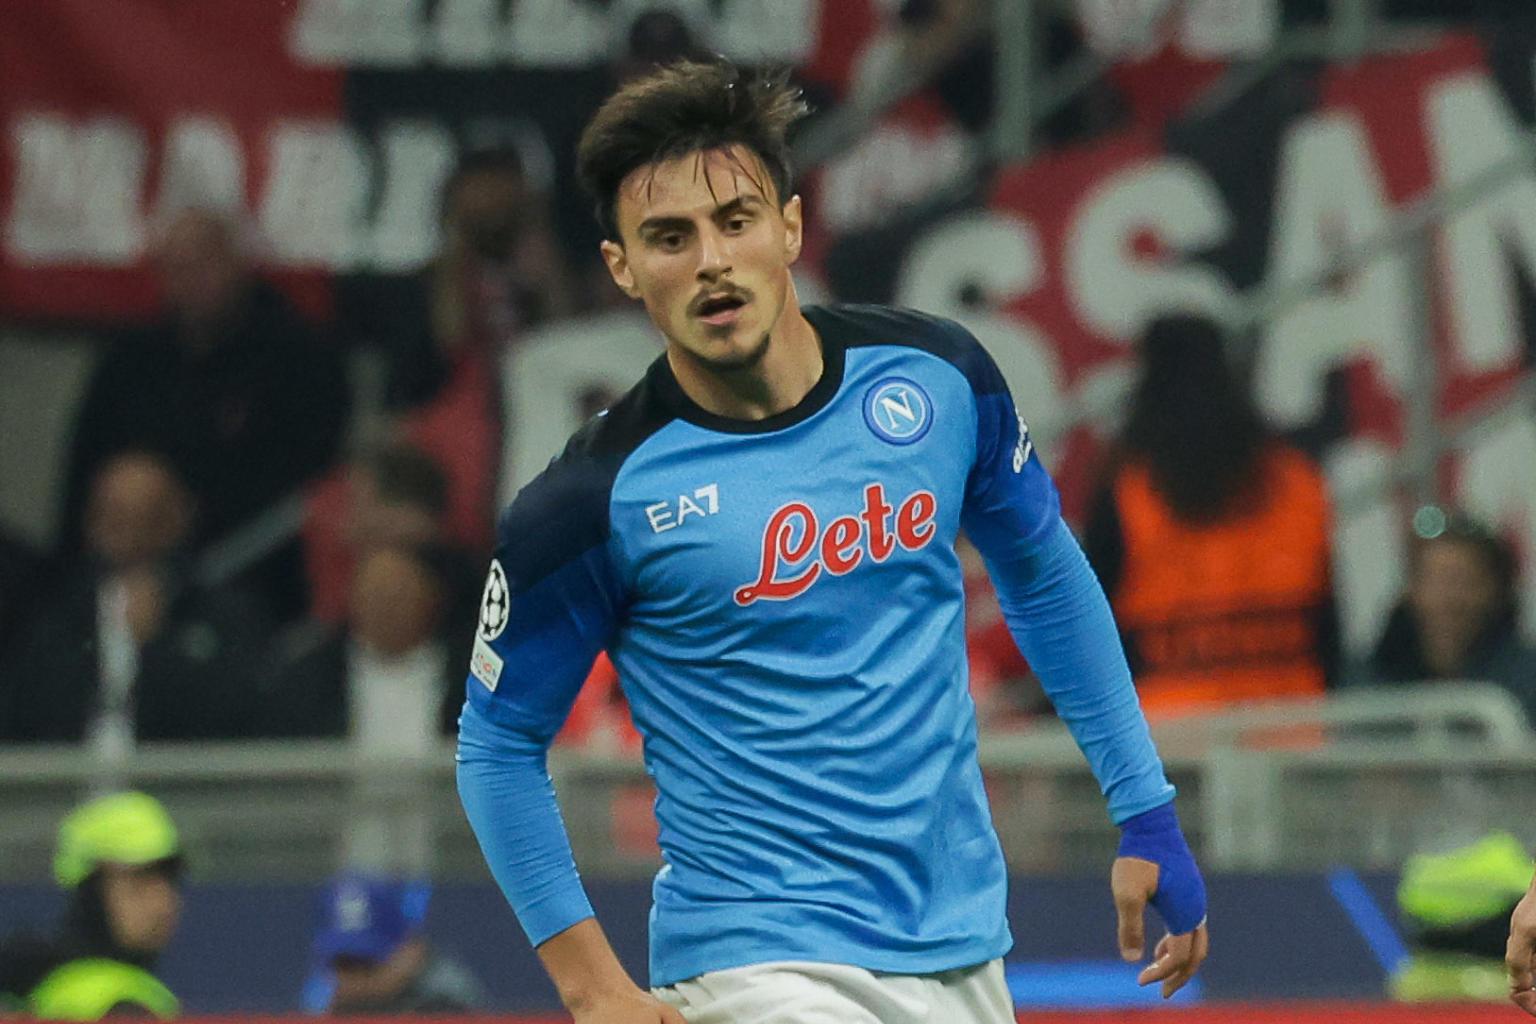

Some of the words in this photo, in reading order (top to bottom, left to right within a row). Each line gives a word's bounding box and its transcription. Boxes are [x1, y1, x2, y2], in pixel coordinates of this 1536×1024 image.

[880, 391, 916, 429] N
[645, 482, 720, 534] EA7
[733, 481, 938, 607] Lete
